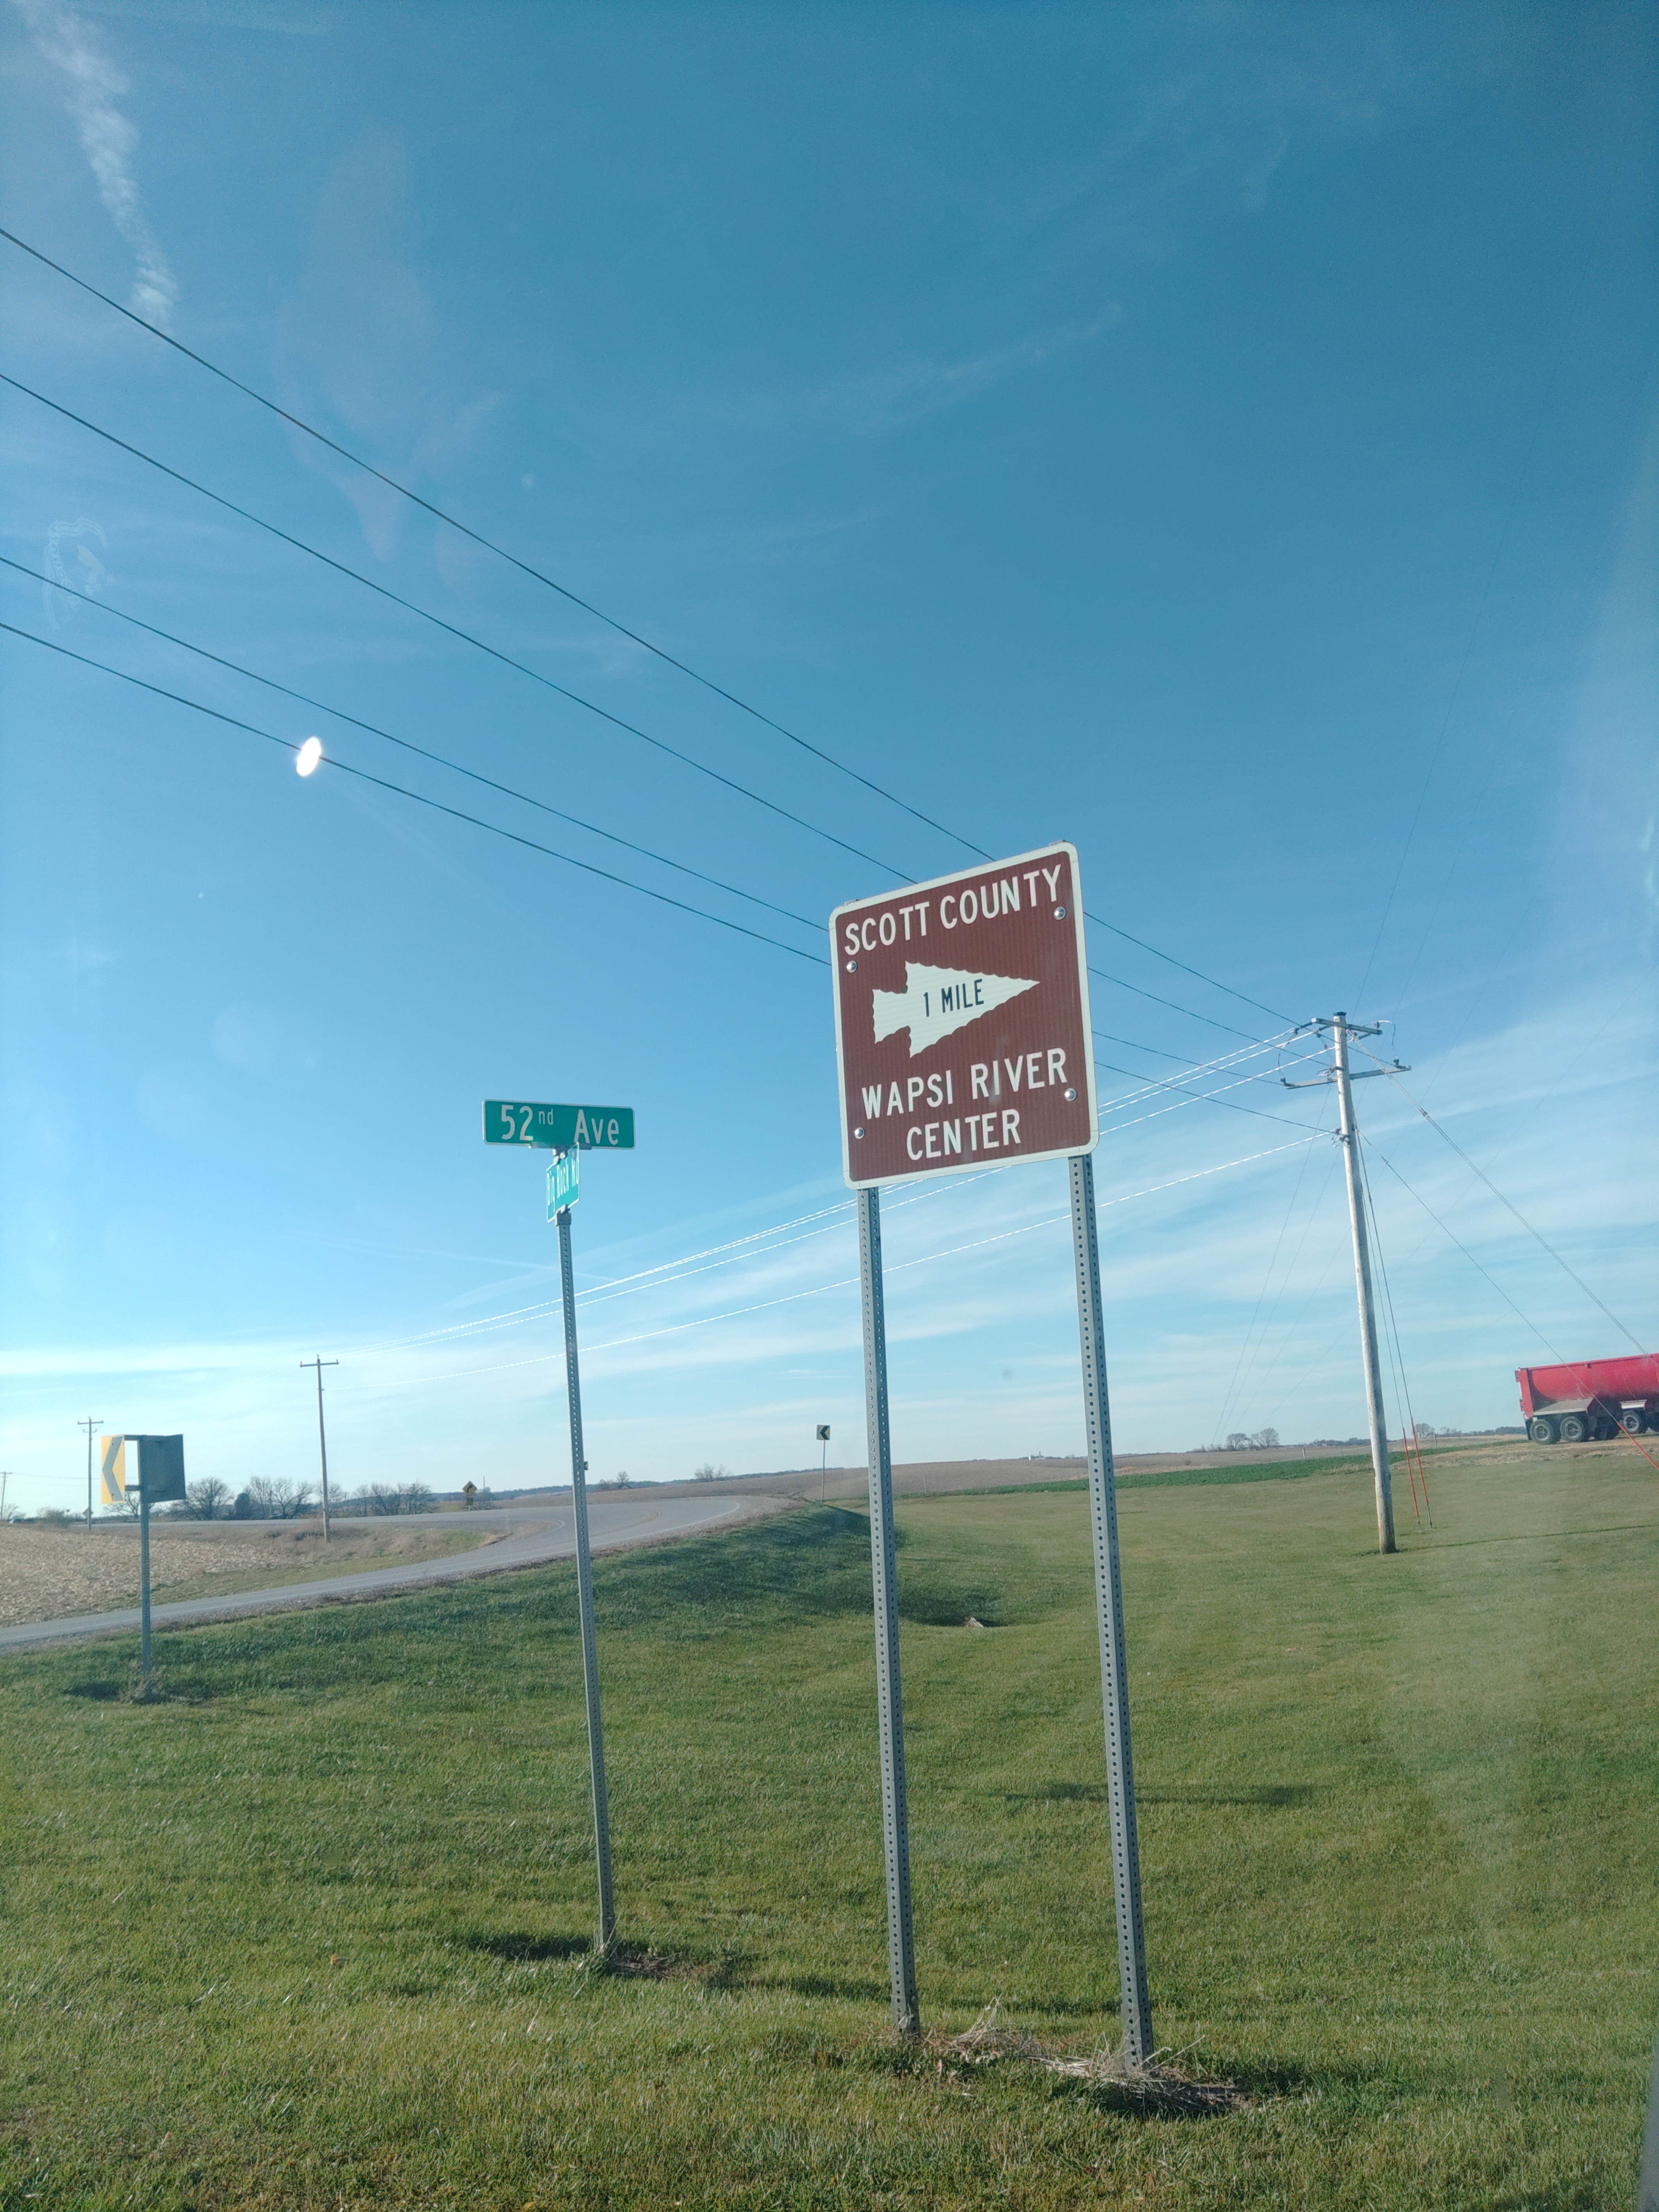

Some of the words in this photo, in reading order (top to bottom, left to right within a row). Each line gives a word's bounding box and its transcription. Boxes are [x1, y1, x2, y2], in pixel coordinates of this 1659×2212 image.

[844, 901, 930, 956] SCOTT
[940, 864, 1061, 929] COUNTY
[923, 992, 930, 1017] 1
[941, 979, 984, 1012] MILE
[862, 1070, 953, 1120] WAPSI
[971, 1047, 1068, 1100] RIVER
[501, 1105, 553, 1140] 52nd
[574, 1109, 619, 1145] Ave
[906, 1109, 1021, 1161] CENTER
[557, 1158, 569, 1199] Rock
